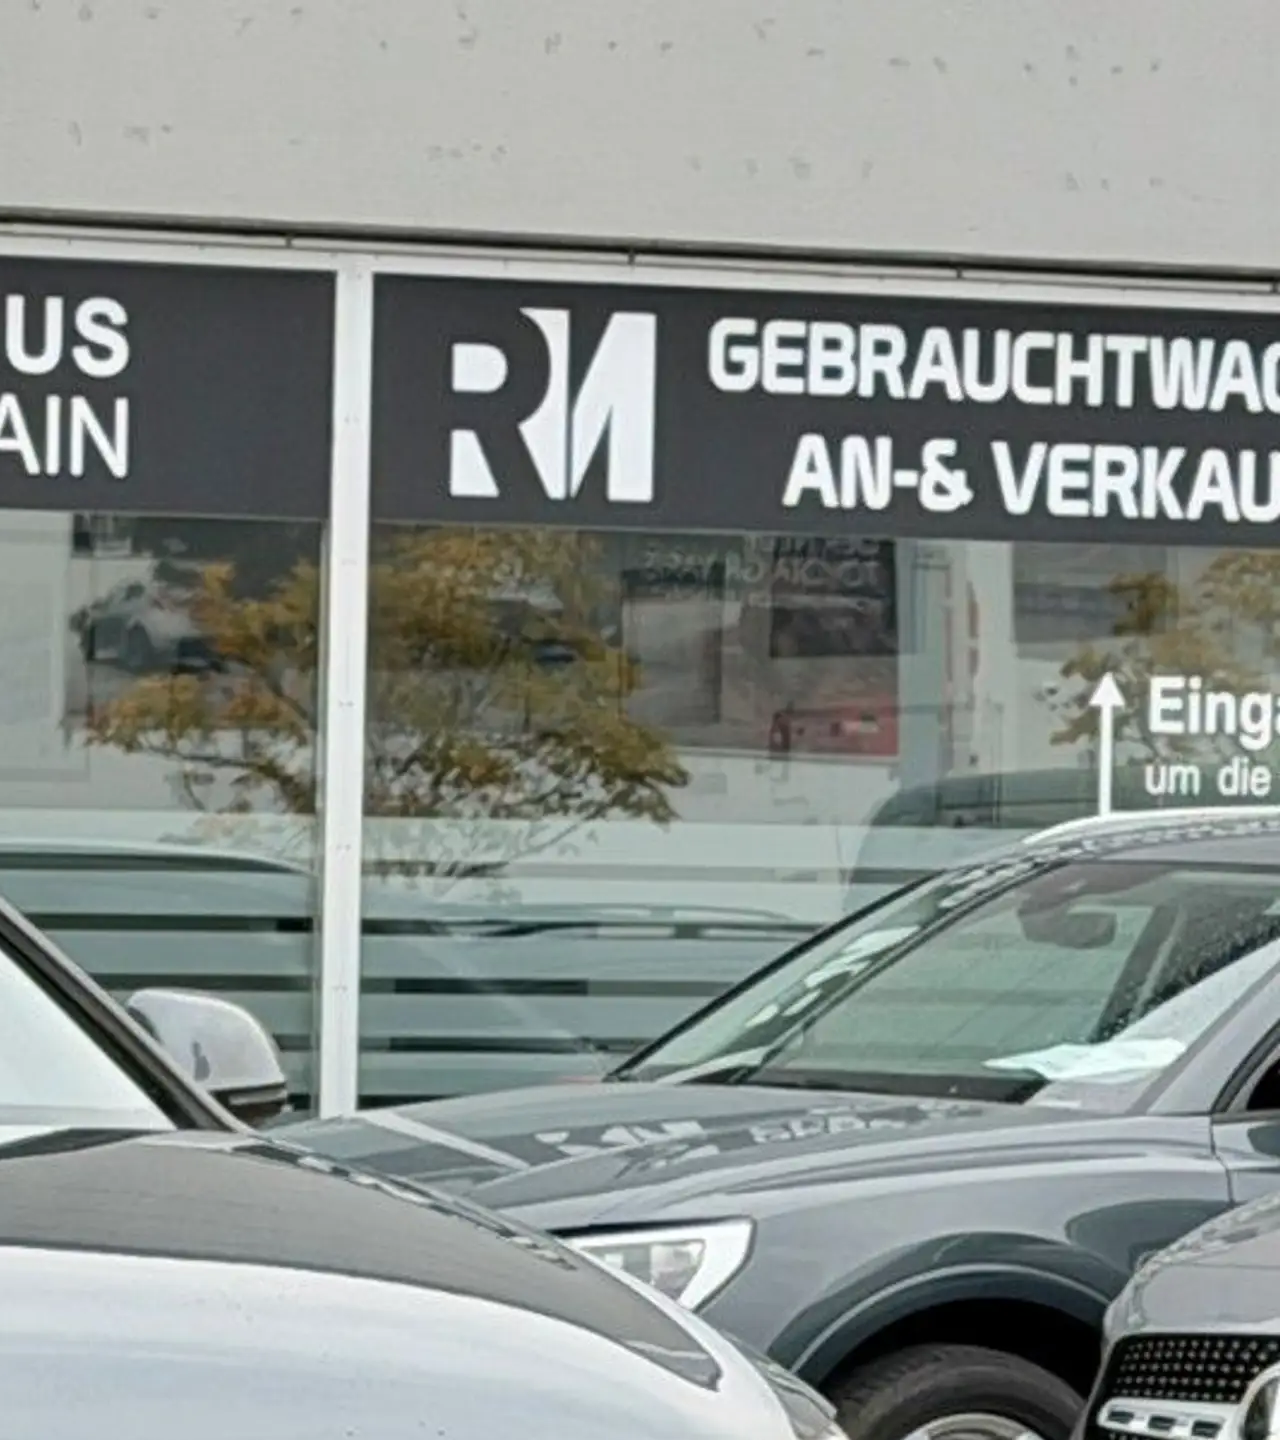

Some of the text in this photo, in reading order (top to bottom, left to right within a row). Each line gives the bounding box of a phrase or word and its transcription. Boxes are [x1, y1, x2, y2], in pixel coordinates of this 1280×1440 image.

[990, 440, 1280, 523] VERKAU
[1149, 674, 1280, 751] Eing
[1144, 756, 1272, 797] um die
